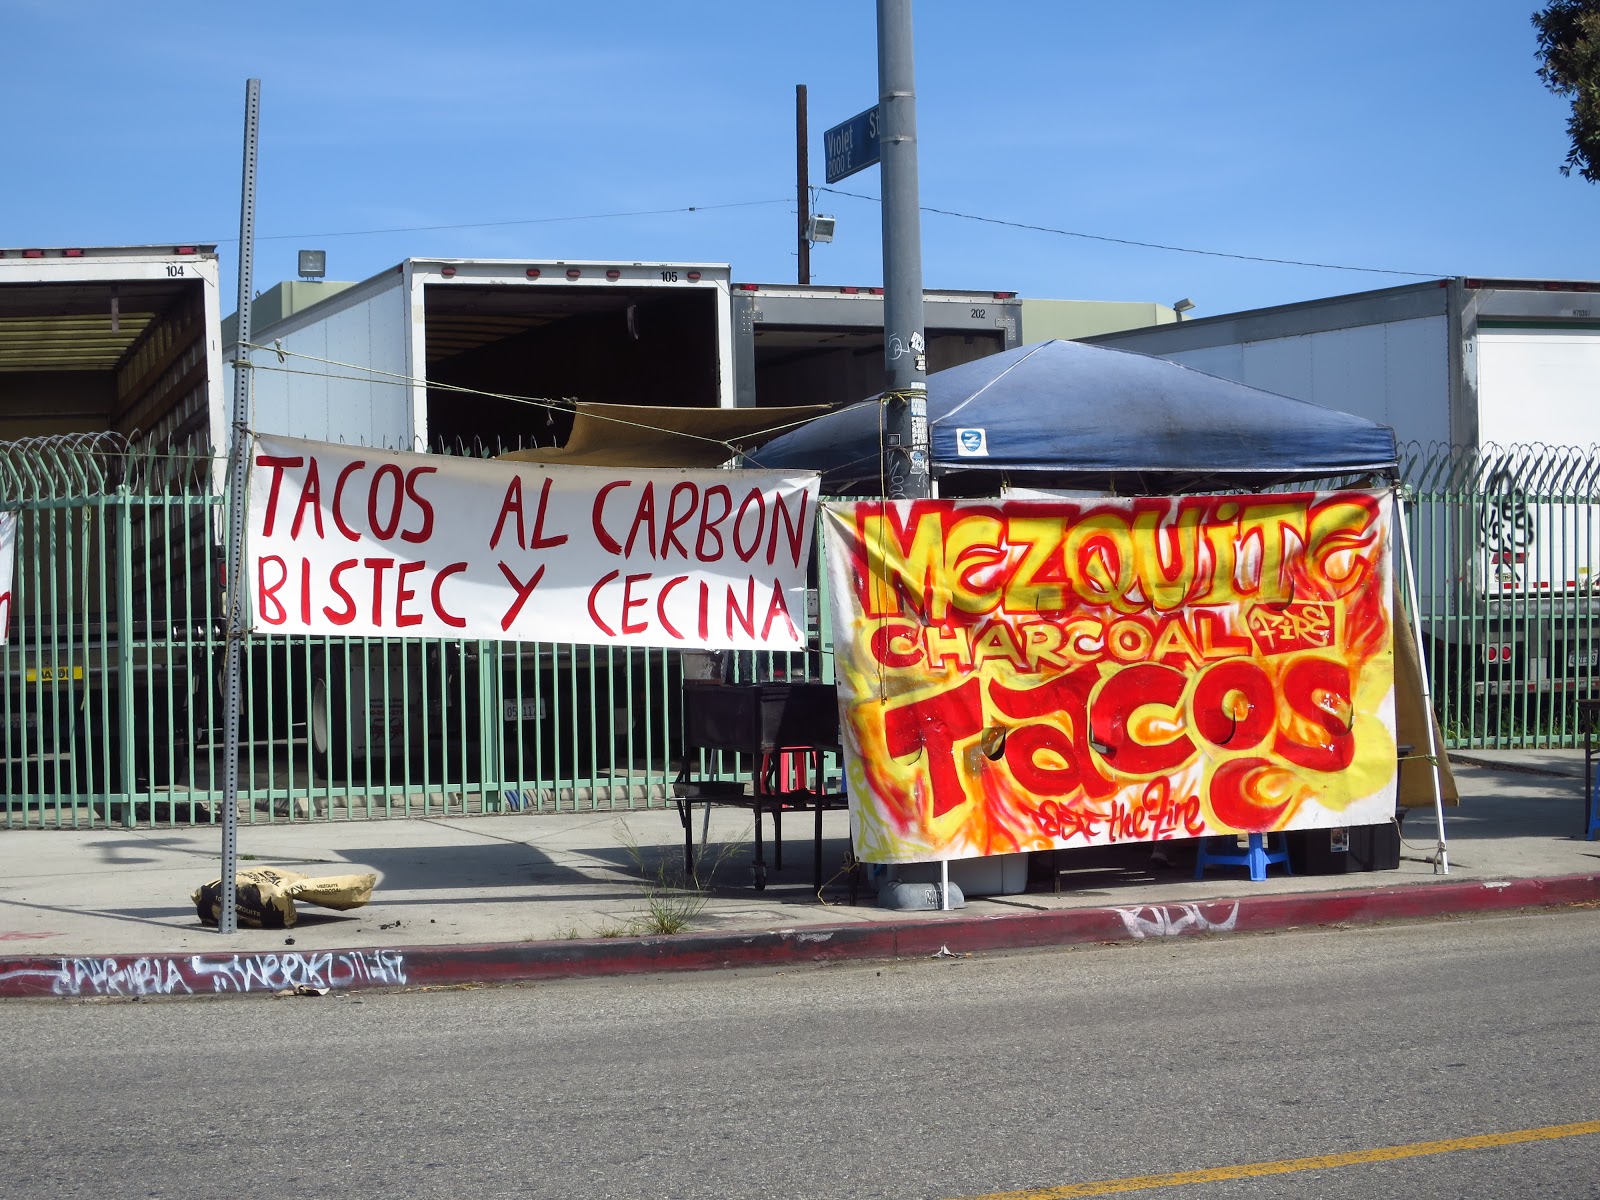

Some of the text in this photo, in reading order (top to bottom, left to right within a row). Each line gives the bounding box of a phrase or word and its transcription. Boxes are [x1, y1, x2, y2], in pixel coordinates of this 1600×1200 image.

[827, 124, 854, 158] Violet
[828, 151, 852, 178] 2000 E
[165, 265, 185, 277] 104
[660, 270, 678, 283] 105
[970, 308, 986, 319] 202
[1464, 343, 1473, 354] 13
[255, 455, 809, 569] TACOS AL CARBON
[258, 554, 799, 642] BISTEC Y CECINA
[870, 608, 1253, 675] CHARCOAL
[1105, 800, 1149, 843] the
